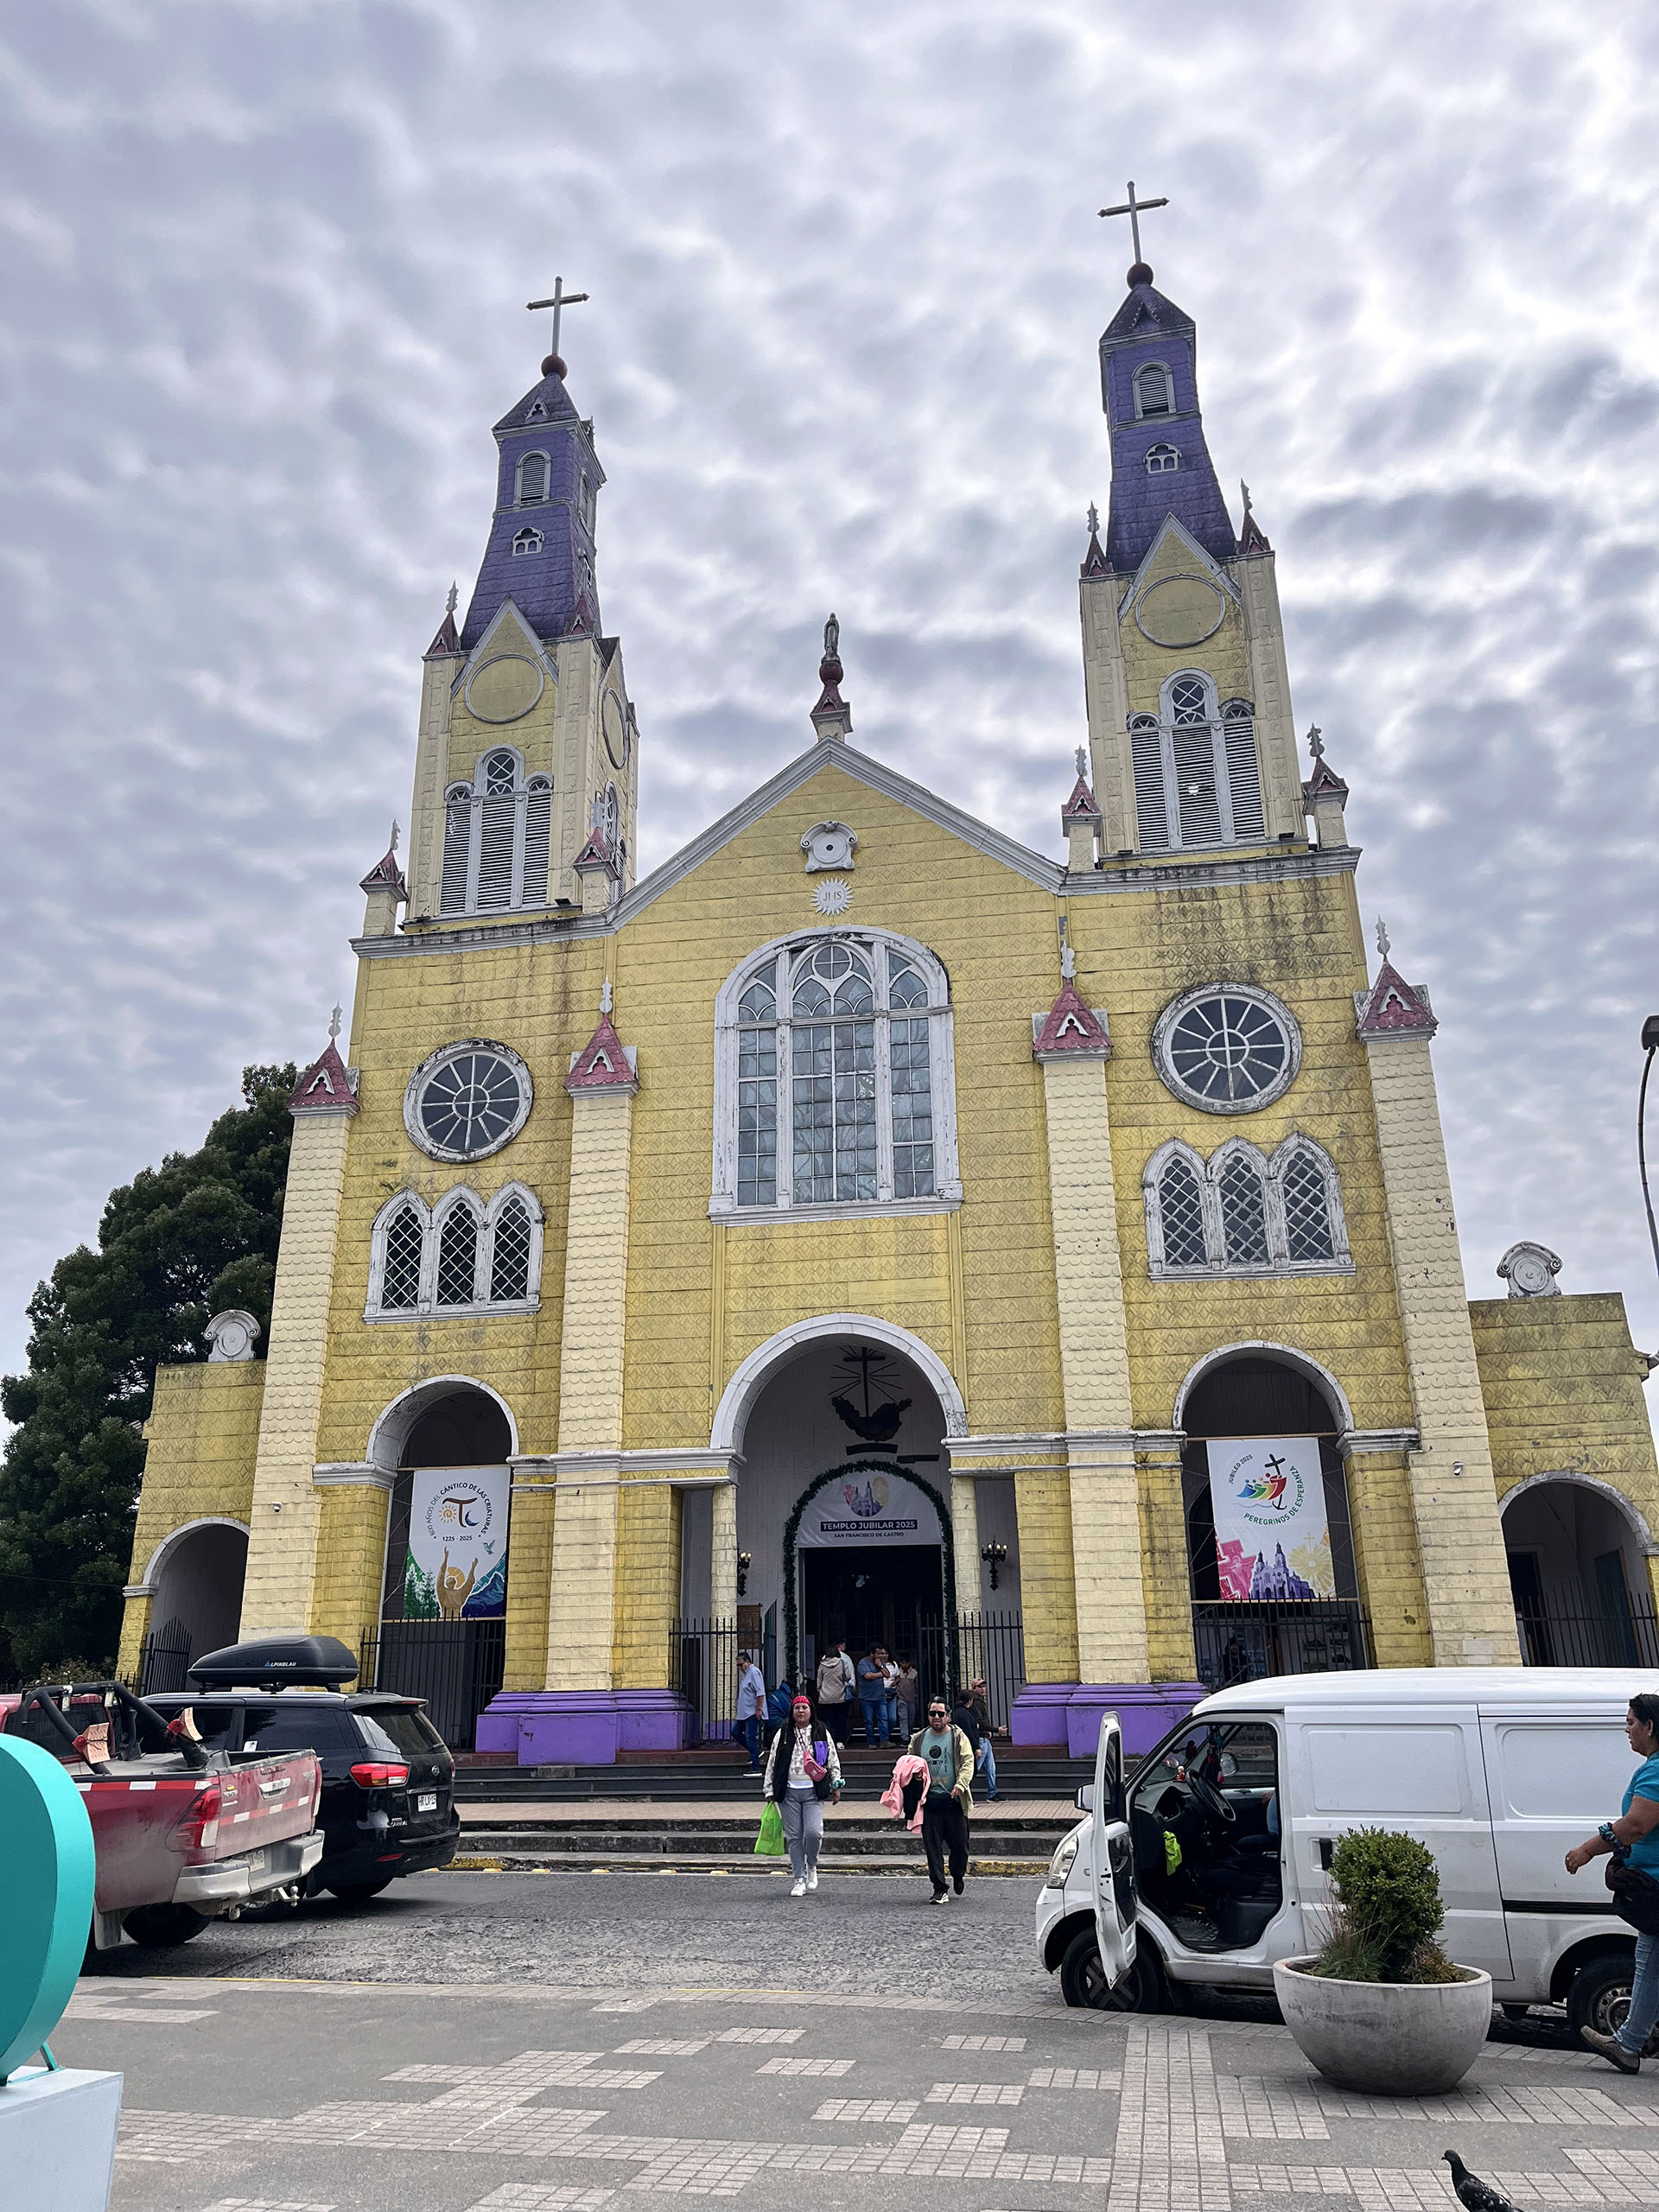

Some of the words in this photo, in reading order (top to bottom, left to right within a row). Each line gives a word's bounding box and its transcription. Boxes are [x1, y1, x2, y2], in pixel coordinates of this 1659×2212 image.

[1229, 1462, 1242, 1484] JUBILEO
[1240, 1454, 1253, 1465] 2025
[468, 1483, 478, 1491] DE
[1290, 1465, 1304, 1507] ESPERANZA
[430, 1494, 442, 1505] DEL
[476, 1488, 487, 1499] LAS
[425, 1505, 434, 1523] AÑOS
[480, 1498, 493, 1535] CRIATURAS
[1289, 1506, 1299, 1516] DE
[1244, 1512, 1290, 1525] PEREGRINOS
